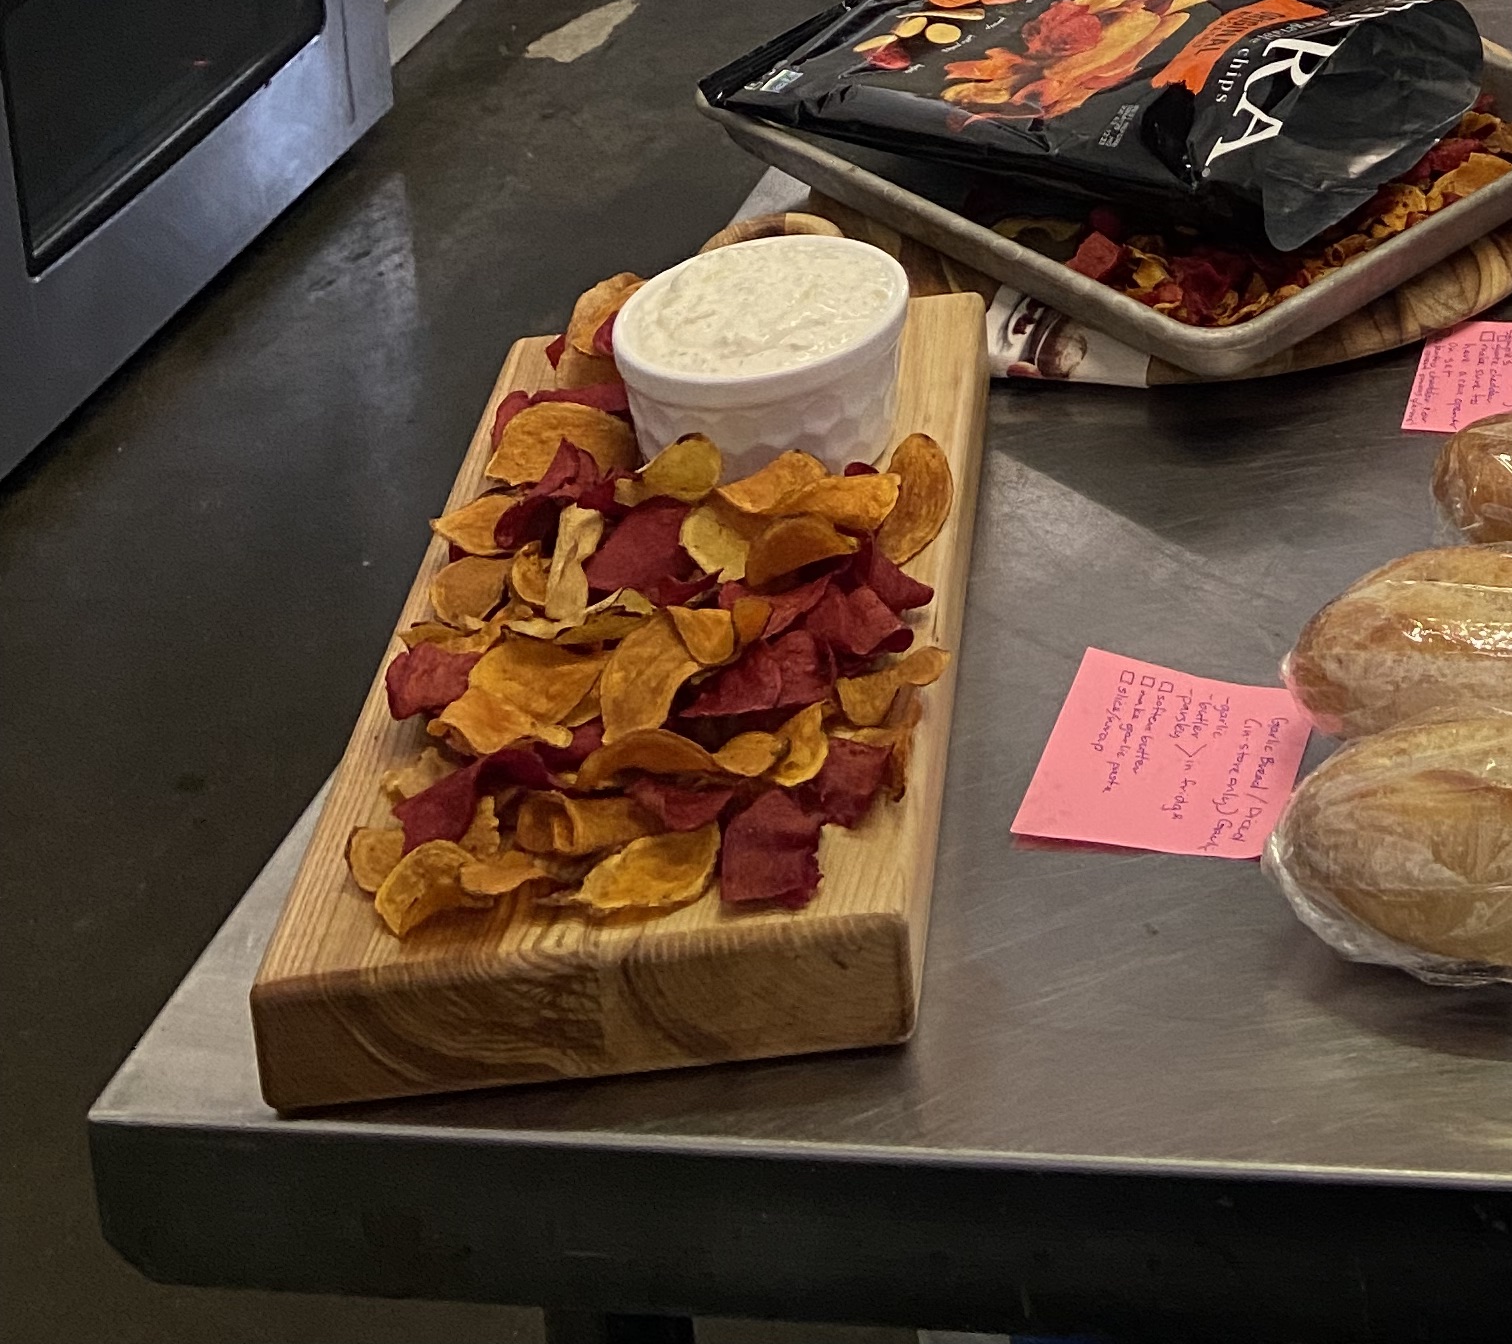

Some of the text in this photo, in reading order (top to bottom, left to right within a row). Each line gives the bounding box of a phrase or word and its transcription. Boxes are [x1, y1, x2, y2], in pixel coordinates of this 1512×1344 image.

[1214, 46, 1251, 105] chips
[1131, 689, 1147, 721] make
[1118, 722, 1135, 761] garlic
[1132, 695, 1167, 776] soften butter
[1263, 716, 1290, 753] Garlic
[1160, 759, 1198, 821] in fridge
[1251, 756, 1275, 791] Bread
[1231, 805, 1263, 844] Diced
